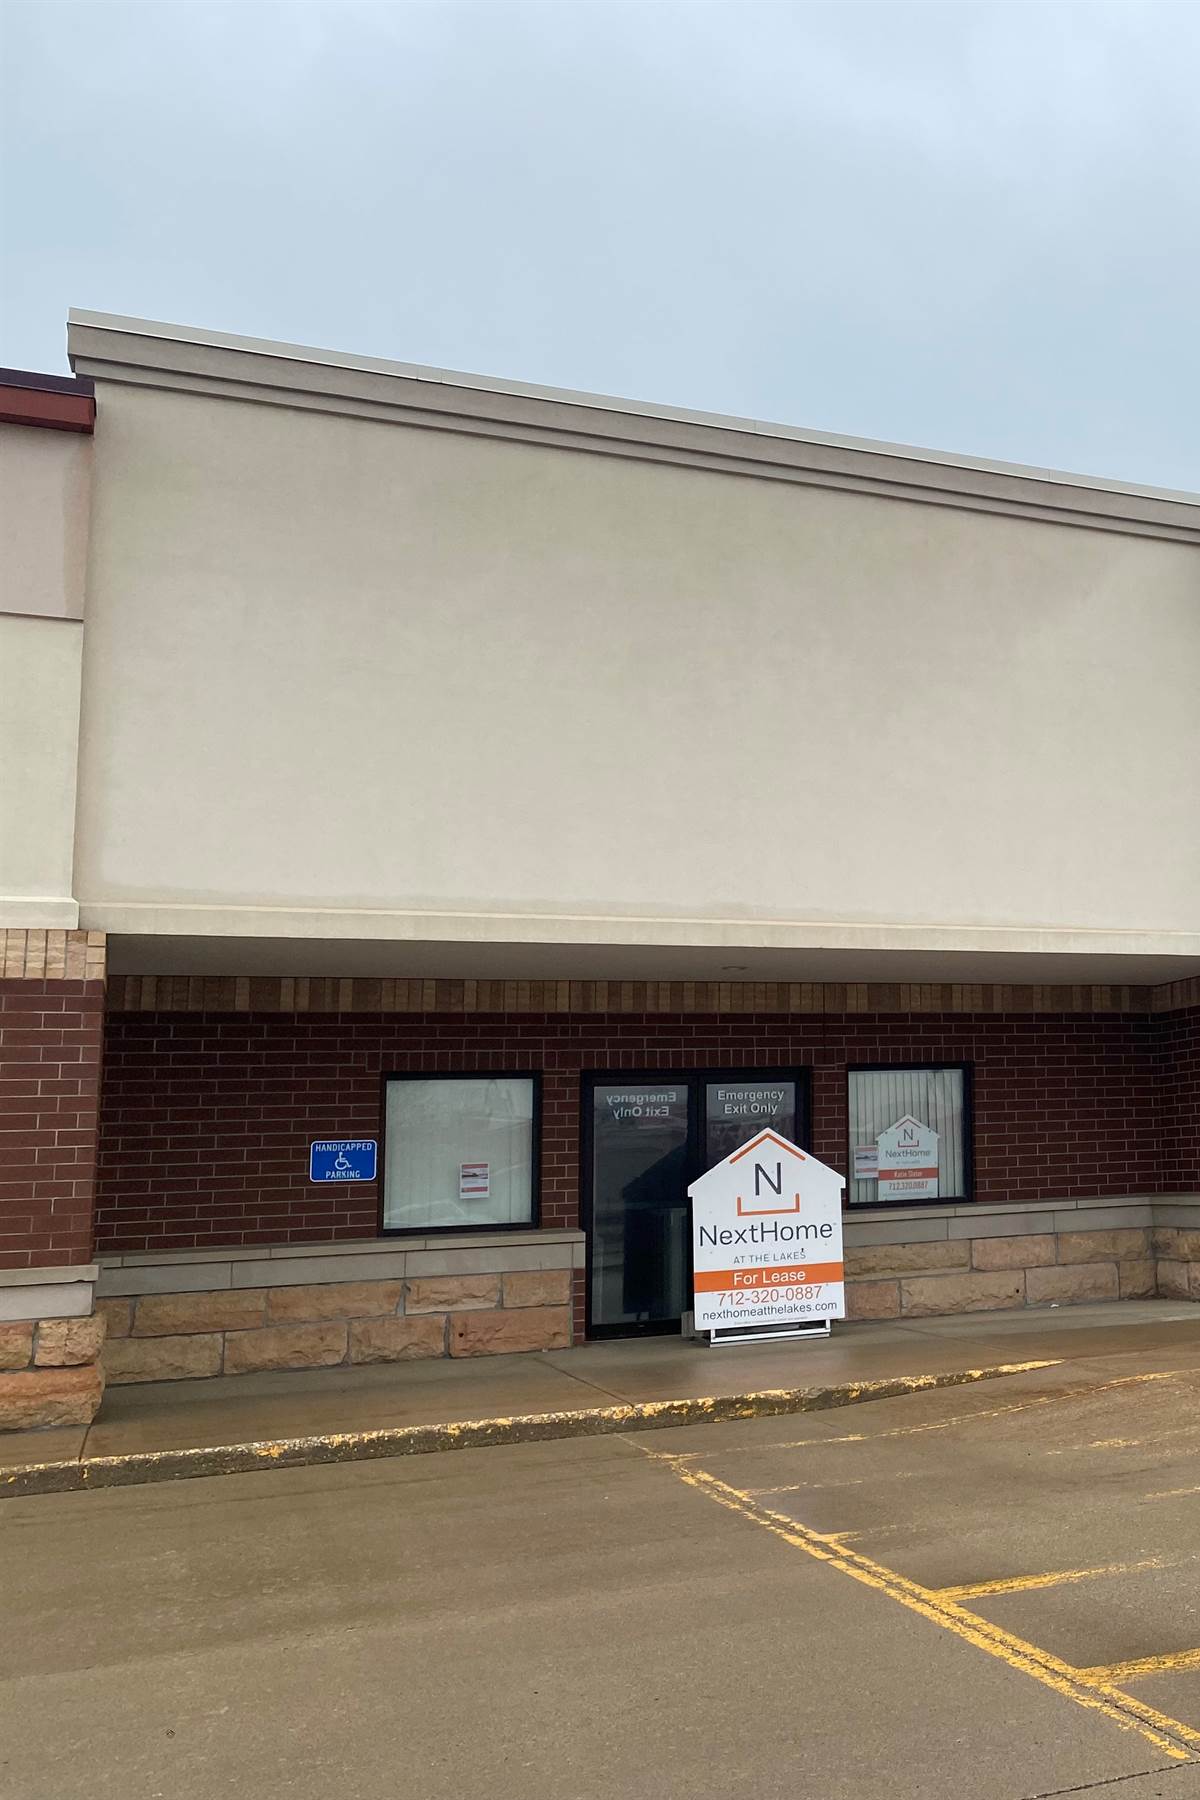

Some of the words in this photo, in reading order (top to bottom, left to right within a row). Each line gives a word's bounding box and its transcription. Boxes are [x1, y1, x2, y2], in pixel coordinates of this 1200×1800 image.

[717, 1089, 785, 1102] Emergency
[724, 1103, 747, 1114] Exit
[751, 1103, 778, 1115] Only
[904, 1129, 913, 1140] N
[315, 1142, 372, 1152] HANDICAPPED
[886, 1150, 930, 1158] NextHome
[325, 1170, 360, 1179] PARKING
[755, 1162, 782, 1196] N
[699, 1221, 833, 1247] NextHome
[733, 1255, 746, 1264] AT
[749, 1253, 770, 1263] THE
[773, 1250, 806, 1262] LAKES
[733, 1271, 759, 1286] For
[762, 1269, 806, 1284] Lease
[718, 1285, 822, 1306] 712-320-0887
[702, 1302, 837, 1320] nexthomeatthelakes.com
